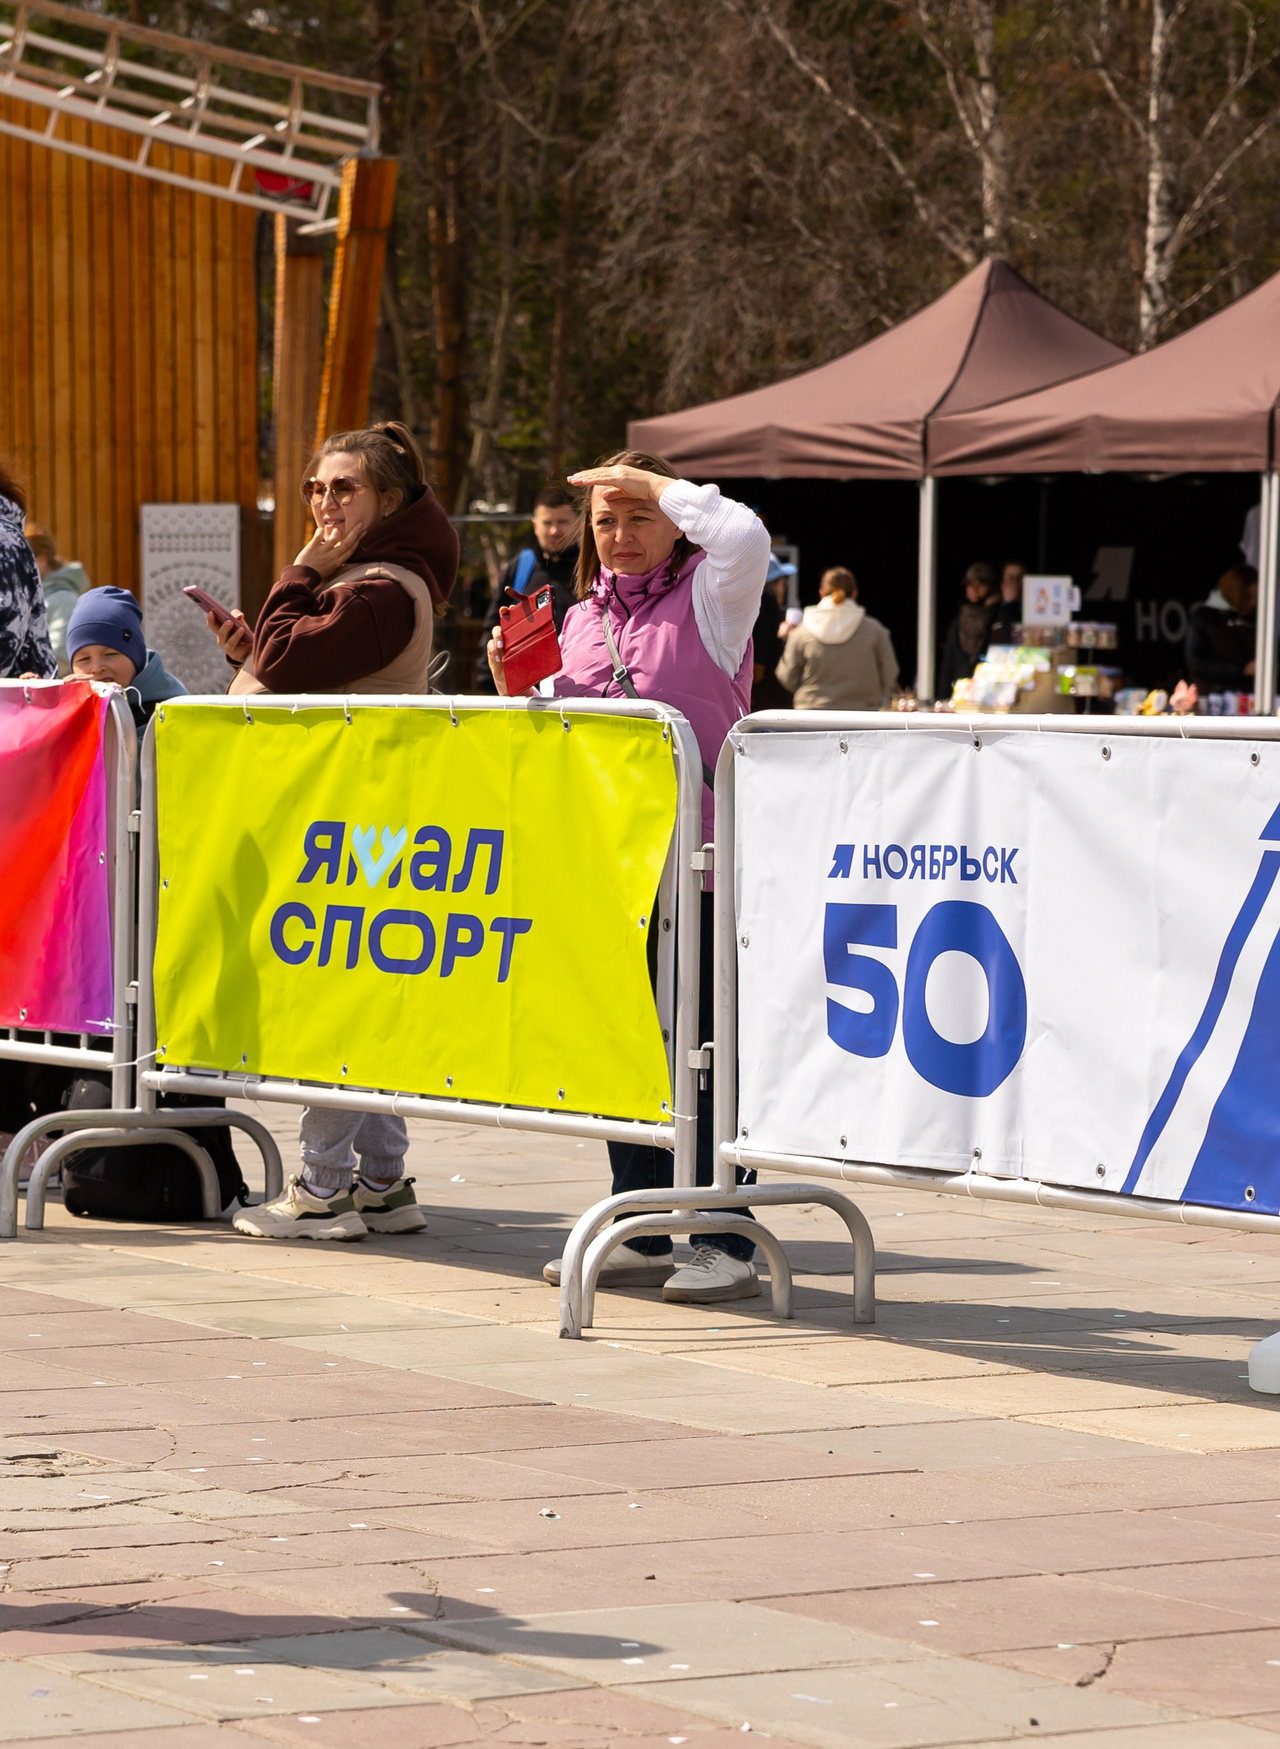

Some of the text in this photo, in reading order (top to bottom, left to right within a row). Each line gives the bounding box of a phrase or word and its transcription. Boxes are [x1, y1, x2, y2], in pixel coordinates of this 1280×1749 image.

[863, 843, 1019, 884] НОЯБРЬСК
[270, 902, 533, 983] СПОРТ
[823, 900, 1028, 1098] 50
